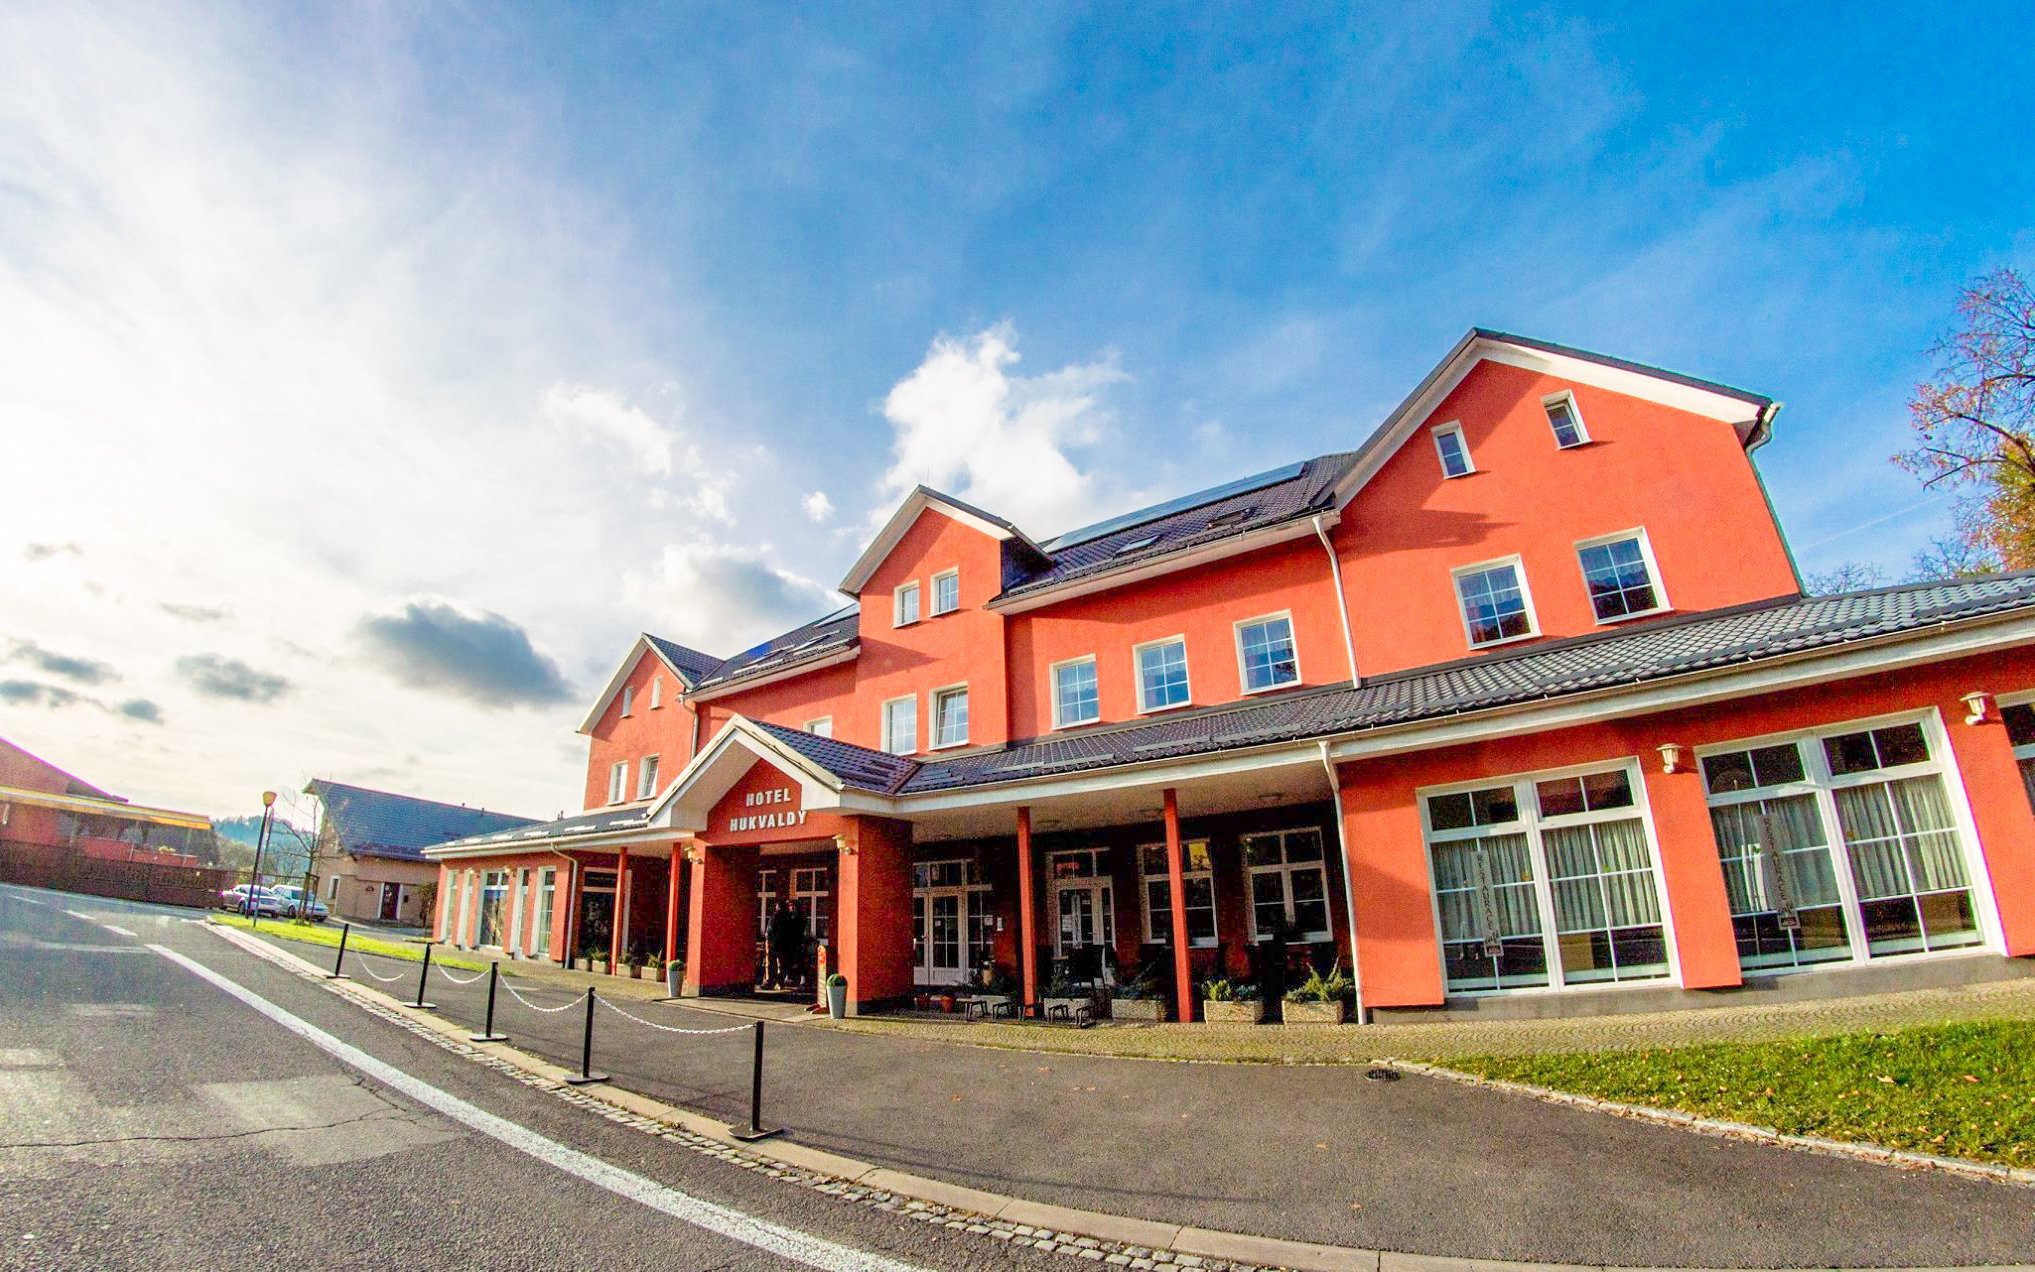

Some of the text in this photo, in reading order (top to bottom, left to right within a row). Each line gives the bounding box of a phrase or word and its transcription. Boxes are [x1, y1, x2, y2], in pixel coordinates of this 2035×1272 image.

[746, 788, 791, 807] HOTEL
[730, 811, 807, 831] HUKVALDY
[1477, 854, 1494, 930] RESTAURACE
